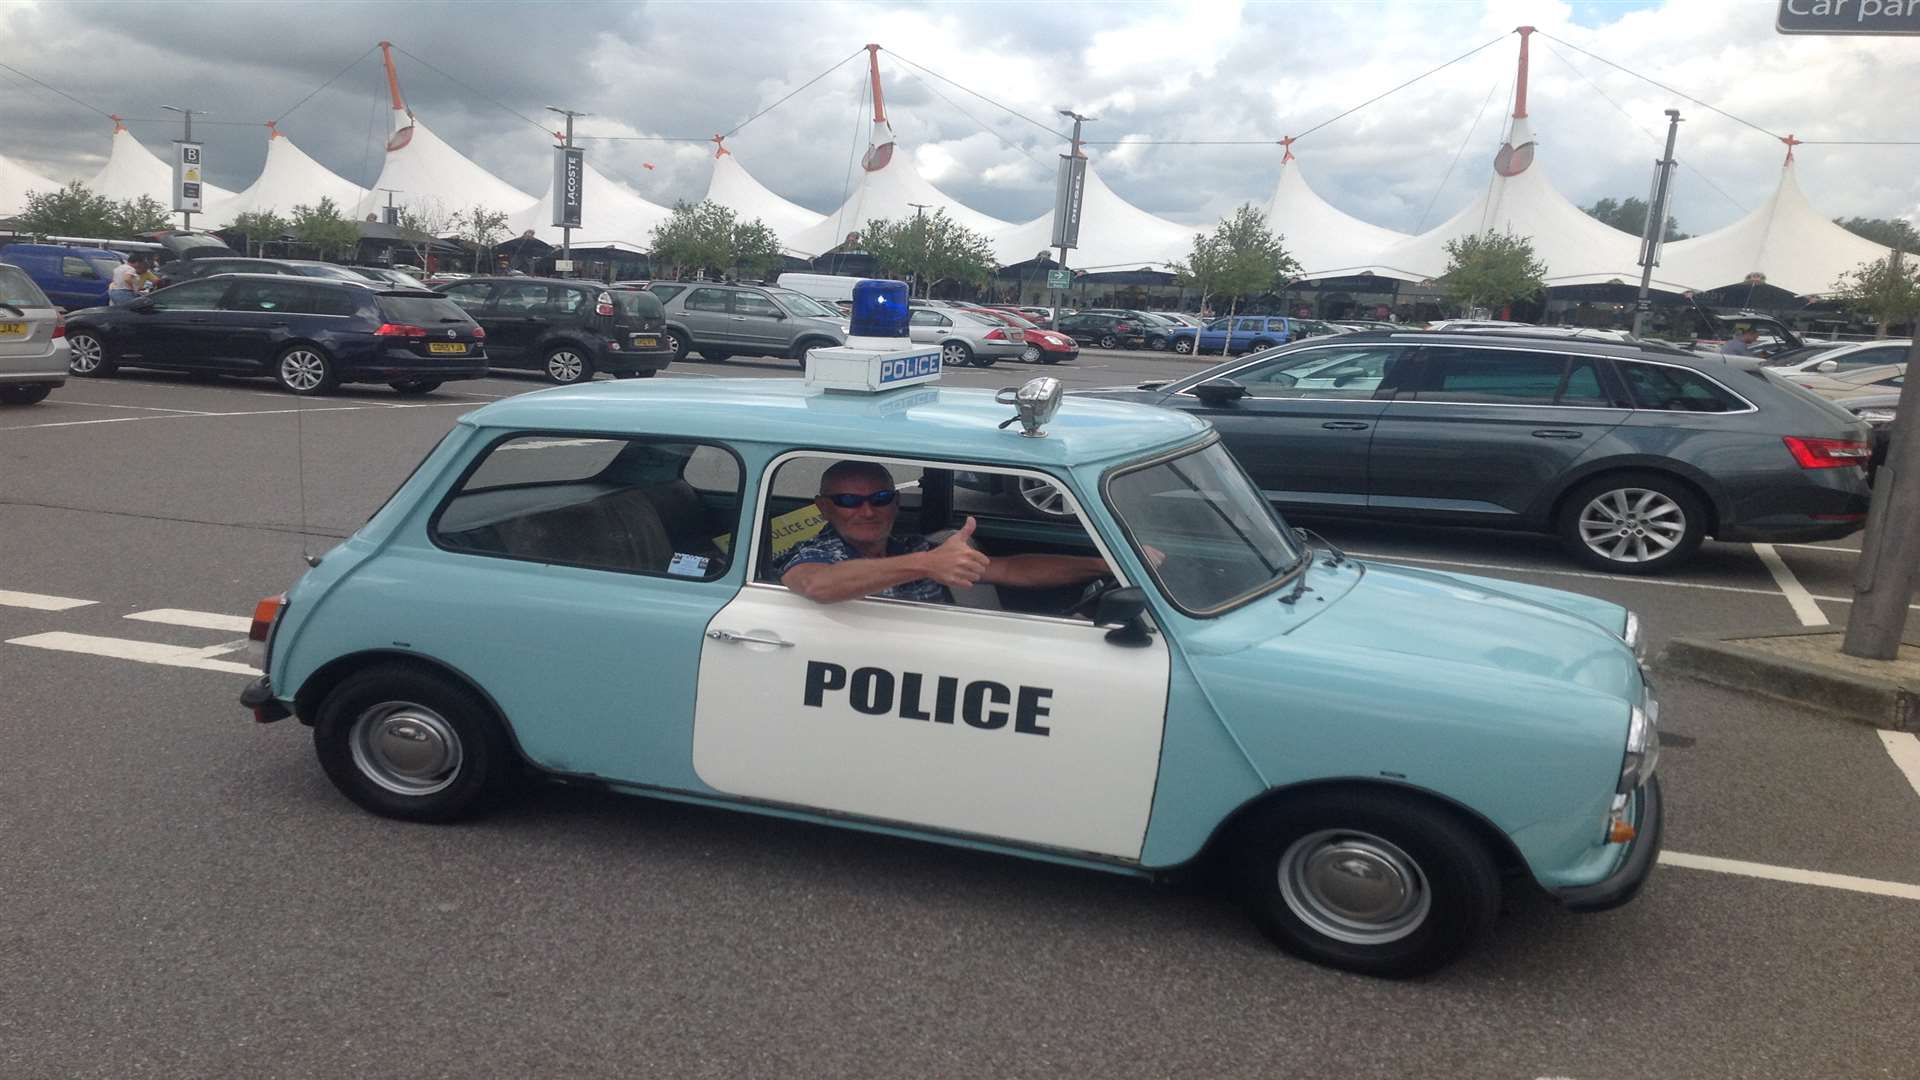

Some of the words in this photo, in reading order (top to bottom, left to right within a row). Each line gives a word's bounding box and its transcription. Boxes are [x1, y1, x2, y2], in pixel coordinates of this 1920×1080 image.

[1787, 0, 1848, 16] Car
[188, 149, 197, 160] B
[567, 157, 576, 206] LACOSTE
[1071, 172, 1081, 223] DIESEL
[881, 354, 939, 382] POLICE
[803, 660, 1053, 736] POLICE
